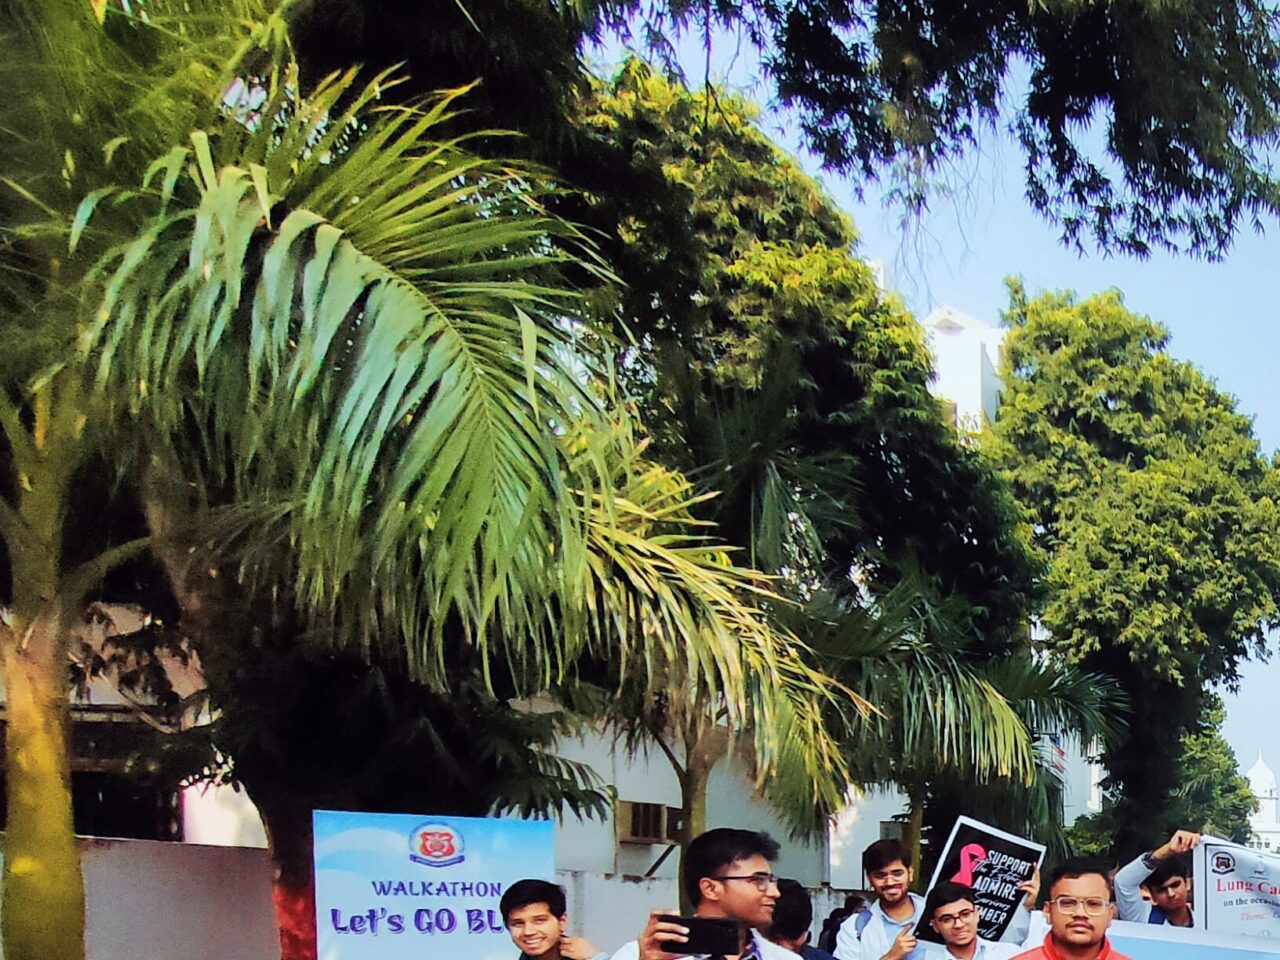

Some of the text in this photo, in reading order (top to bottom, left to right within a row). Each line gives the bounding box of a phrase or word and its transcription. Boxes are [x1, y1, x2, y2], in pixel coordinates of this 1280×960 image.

[986, 850, 1031, 875] SUPPORT
[372, 880, 502, 897] WALKATHON
[971, 876, 1017, 900] ADMIRE
[1216, 879, 1253, 893] Lung
[1236, 897, 1248, 905] the
[330, 907, 504, 936] Let's GO BL
[976, 905, 1007, 924] MBER
